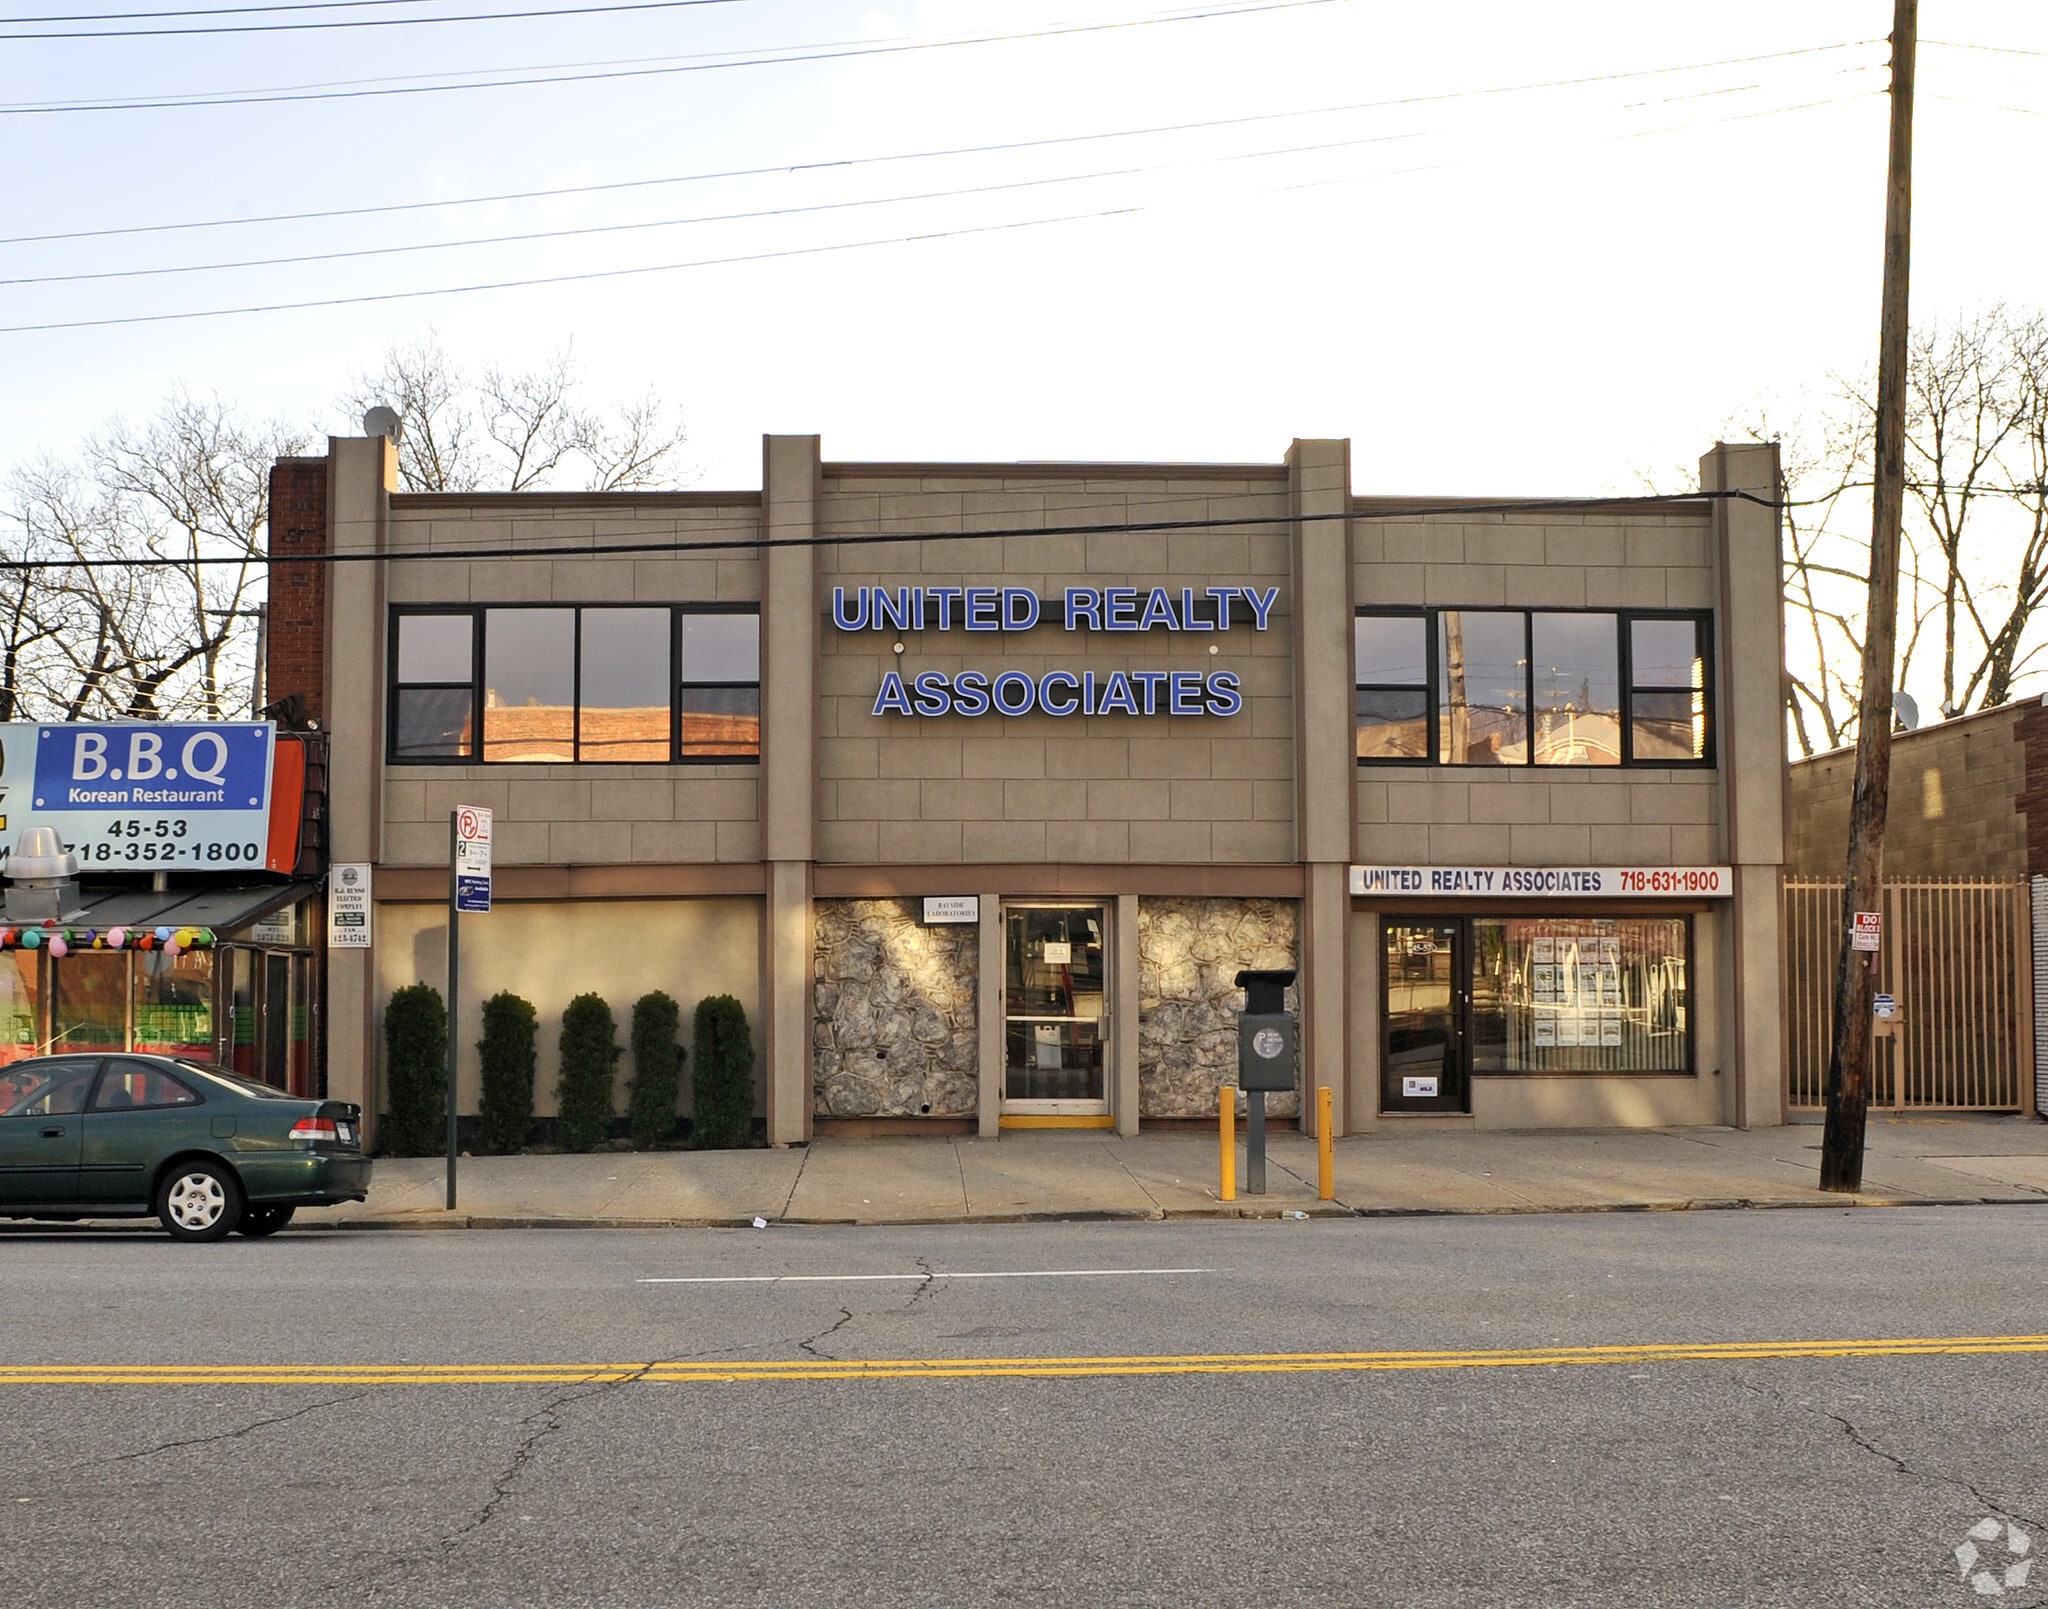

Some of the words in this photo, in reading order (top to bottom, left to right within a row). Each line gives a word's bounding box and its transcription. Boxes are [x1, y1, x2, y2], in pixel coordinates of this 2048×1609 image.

[833, 586, 1040, 631] UNITED
[1064, 586, 1280, 631] REALTY
[872, 671, 1243, 716] ASSOCIATES
[72, 731, 228, 786] B.B.Q
[68, 788, 128, 803] Korean
[132, 788, 225, 803] Restaurant
[107, 820, 188, 838] 45-53
[1363, 870, 1422, 890] UNITED
[1432, 871, 1494, 891] REALTY
[1502, 871, 1601, 892] ASSOCIATES
